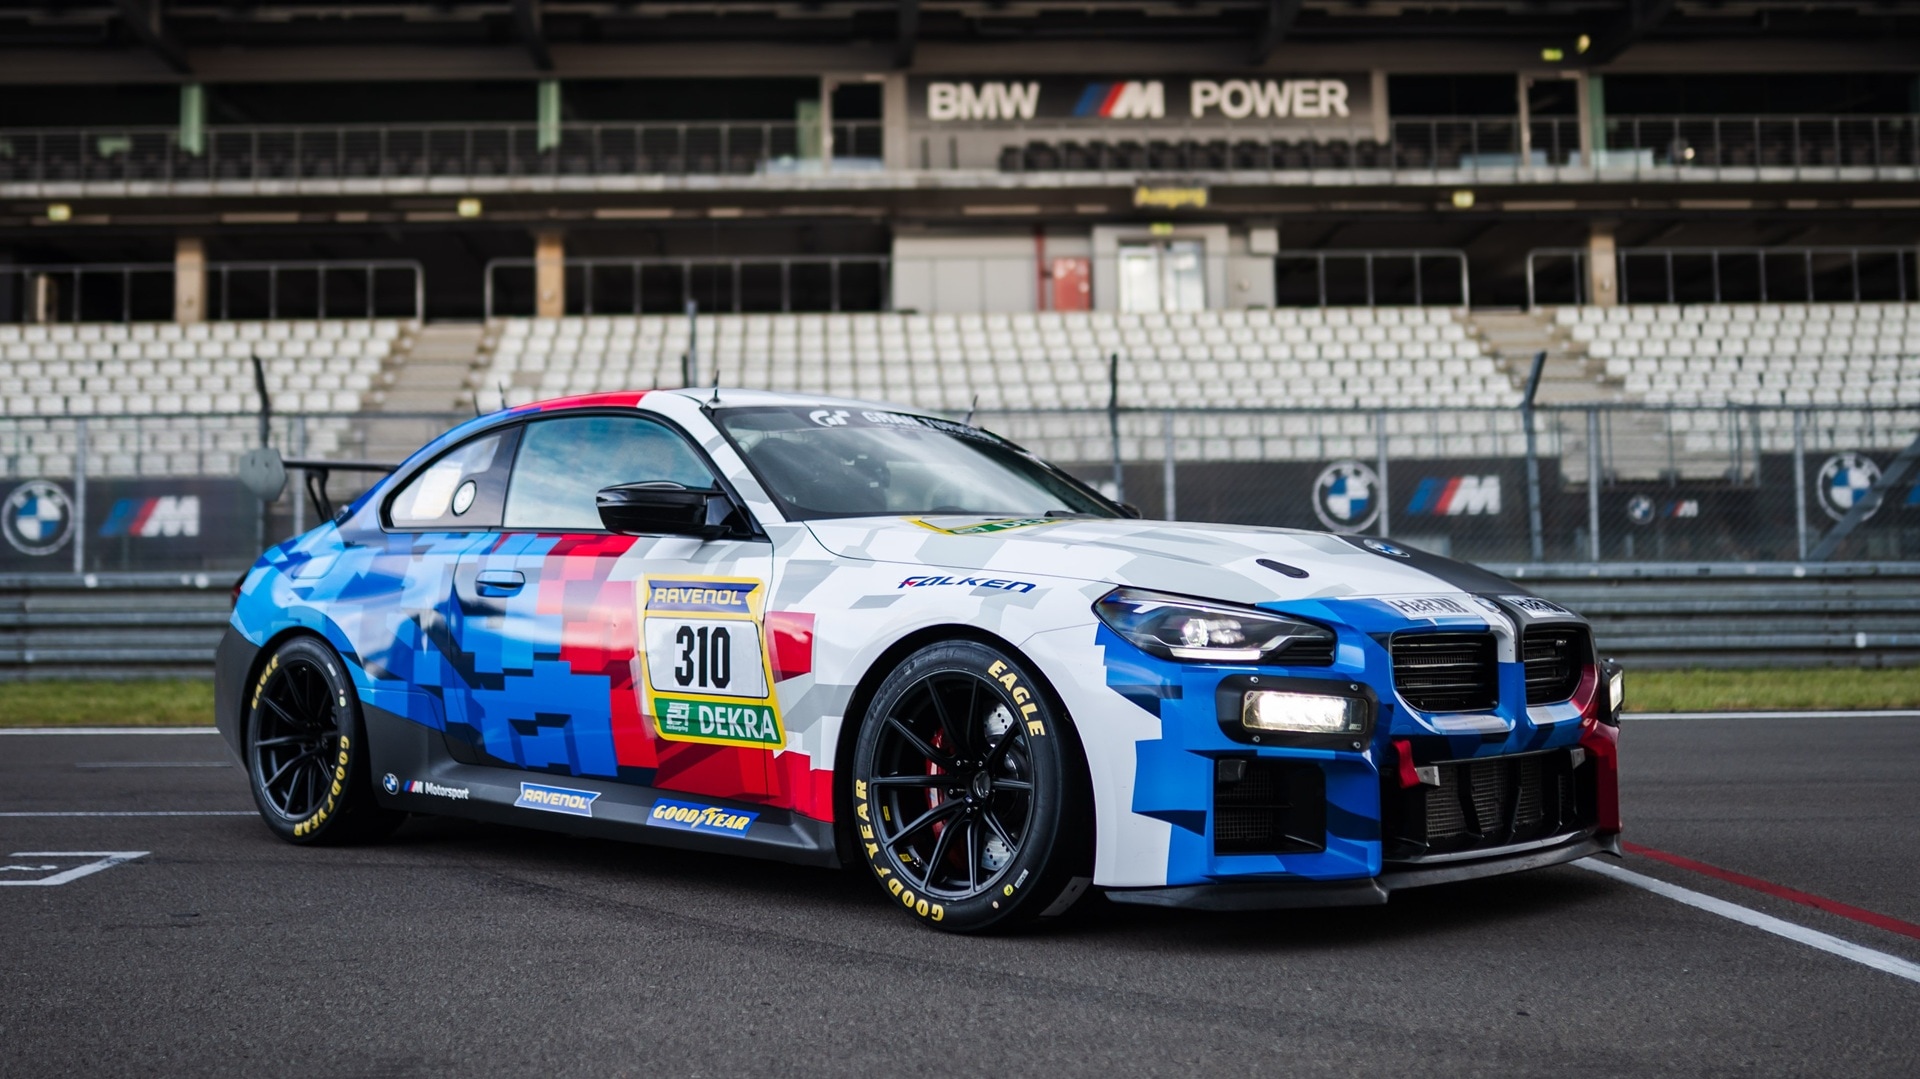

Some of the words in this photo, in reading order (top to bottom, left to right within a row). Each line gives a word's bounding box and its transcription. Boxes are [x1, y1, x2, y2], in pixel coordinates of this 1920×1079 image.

[926, 82, 1040, 120] BMW
[1190, 80, 1349, 118] POWER
[861, 411, 920, 426] GRAN
[654, 588, 742, 605] RAVENOL
[897, 576, 1037, 593] FALKEN
[674, 625, 731, 689] 310
[987, 660, 1045, 737] EAGLE
[698, 705, 778, 740] DEKRA
[425, 781, 469, 801] Motorsport
[523, 788, 588, 810] RAVENOL
[653, 804, 750, 831] GOODYEAR
[855, 778, 945, 922] GOODYEAR
